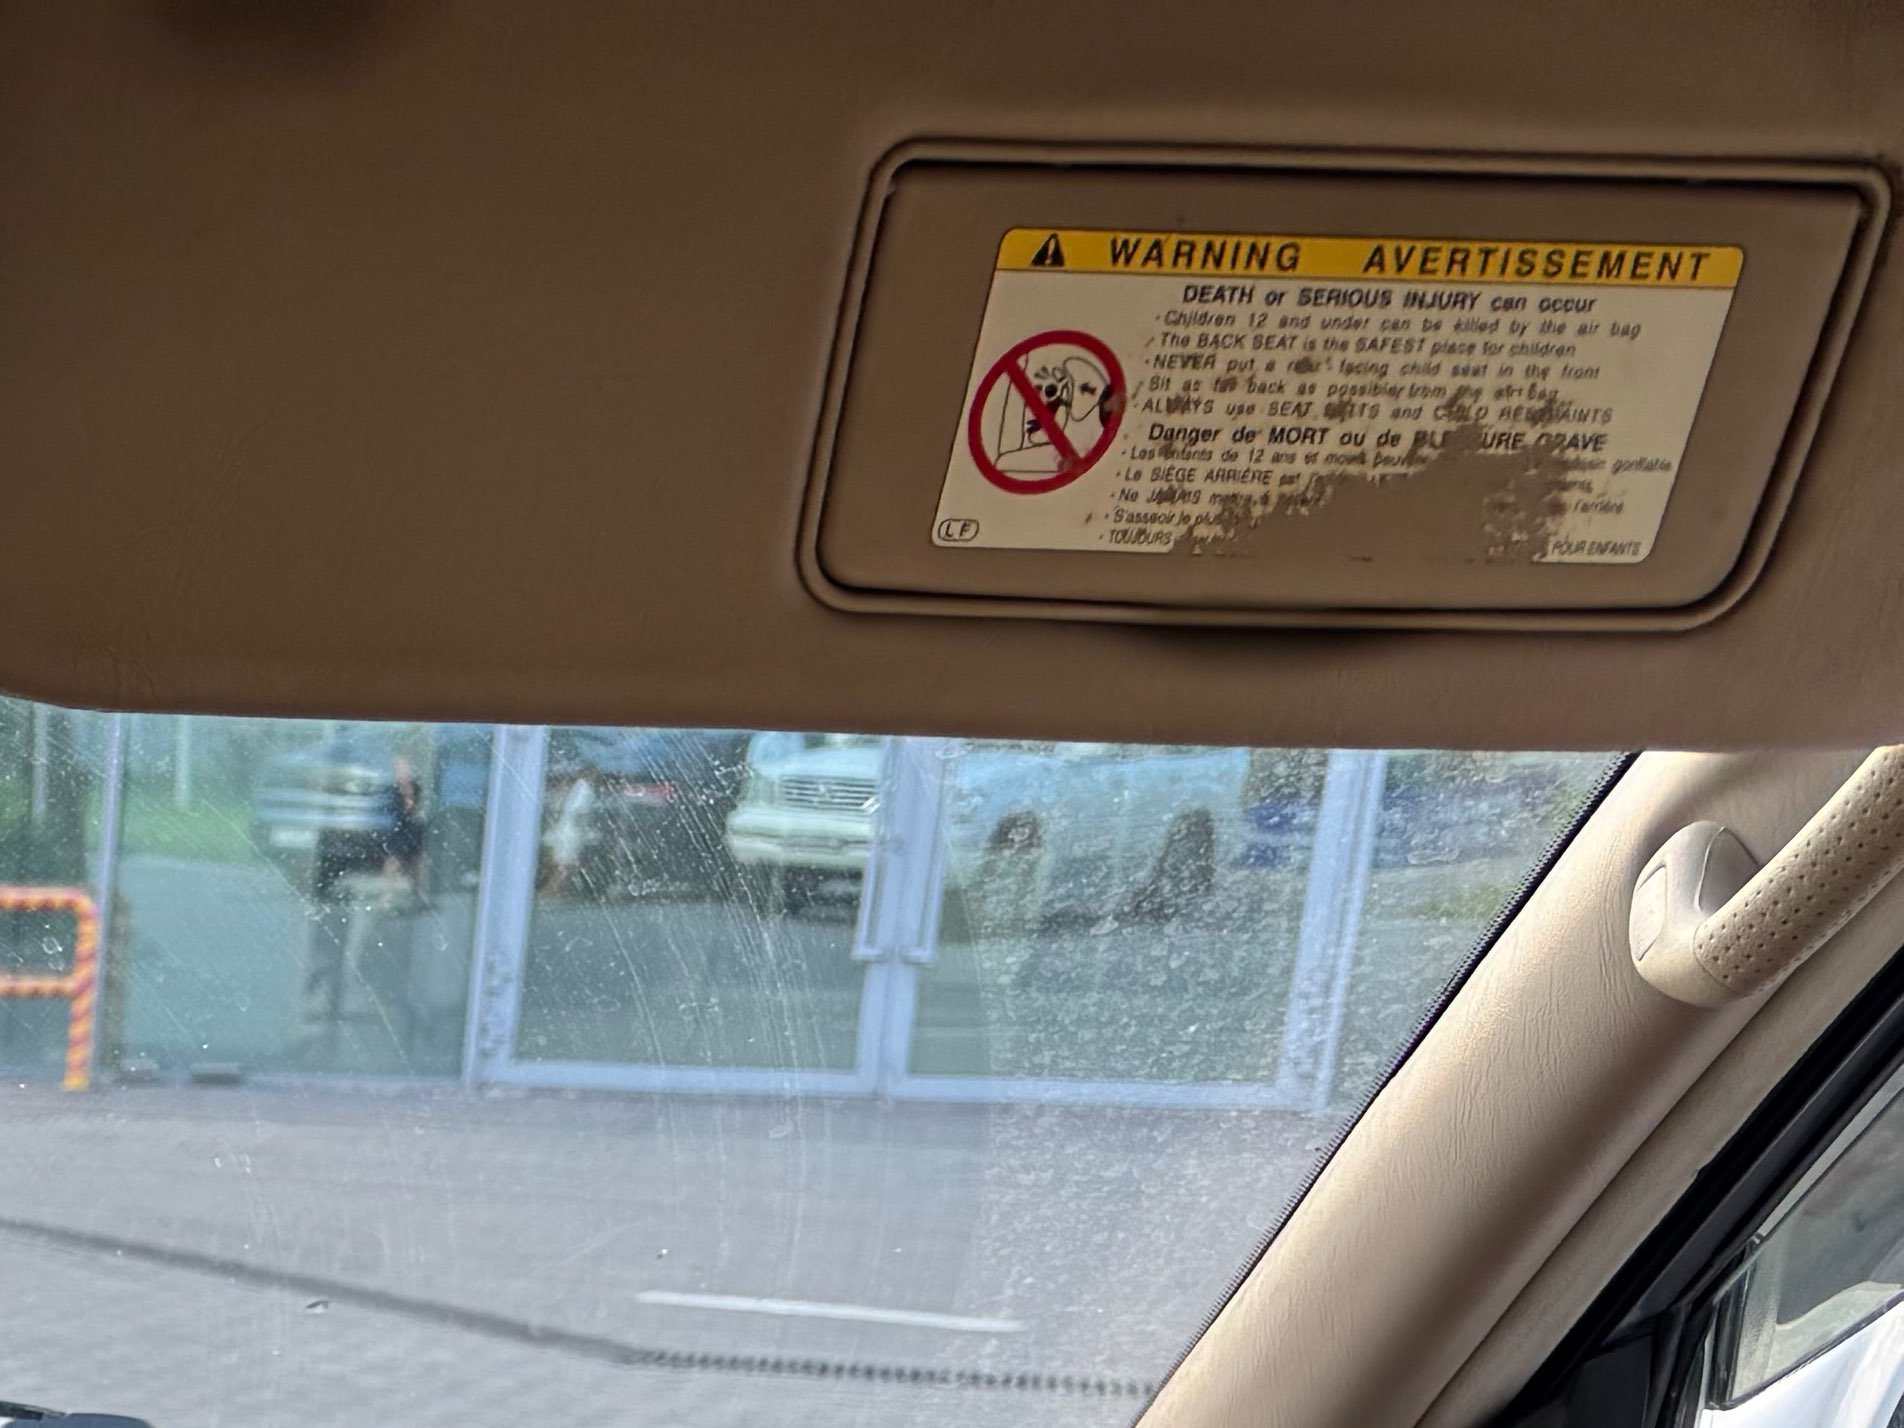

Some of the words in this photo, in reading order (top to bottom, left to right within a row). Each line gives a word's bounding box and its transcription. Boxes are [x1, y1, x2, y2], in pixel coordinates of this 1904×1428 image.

[1109, 237, 1302, 273] WARNING
[1363, 244, 1711, 280] AVERTISSEMENT
[1182, 284, 1256, 304] DEATH
[1265, 289, 1288, 306] or
[1296, 286, 1393, 308] SERIOUS
[1403, 290, 1482, 311] INJURY
[1490, 294, 1527, 312] can
[1537, 297, 1597, 313] occur
[1164, 310, 1236, 327] Children
[1248, 312, 1268, 327] 12
[1279, 313, 1312, 329] and
[1320, 315, 1370, 331] under
[1379, 317, 1412, 332] can
[1453, 318, 1500, 334] killed
[1508, 318, 1528, 338] by
[1539, 319, 1567, 336] the
[1577, 320, 1599, 336] air
[1610, 321, 1642, 341] bag
[1159, 332, 1190, 349] The
[1197, 333, 1243, 349] BACK
[1252, 334, 1298, 351] SEAT
[1323, 335, 1349, 352] the
[1355, 336, 1425, 354] SAFEST
[1431, 341, 1476, 358] place
[1509, 341, 1577, 359] children
[1153, 353, 1217, 370] NEVER
[1226, 358, 1257, 375] put
[1147, 423, 1222, 446] Danger
[1232, 426, 1258, 444] de
[1267, 425, 1330, 445] MORT
[1339, 431, 1365, 447] ou
[1376, 427, 1402, 447] de
